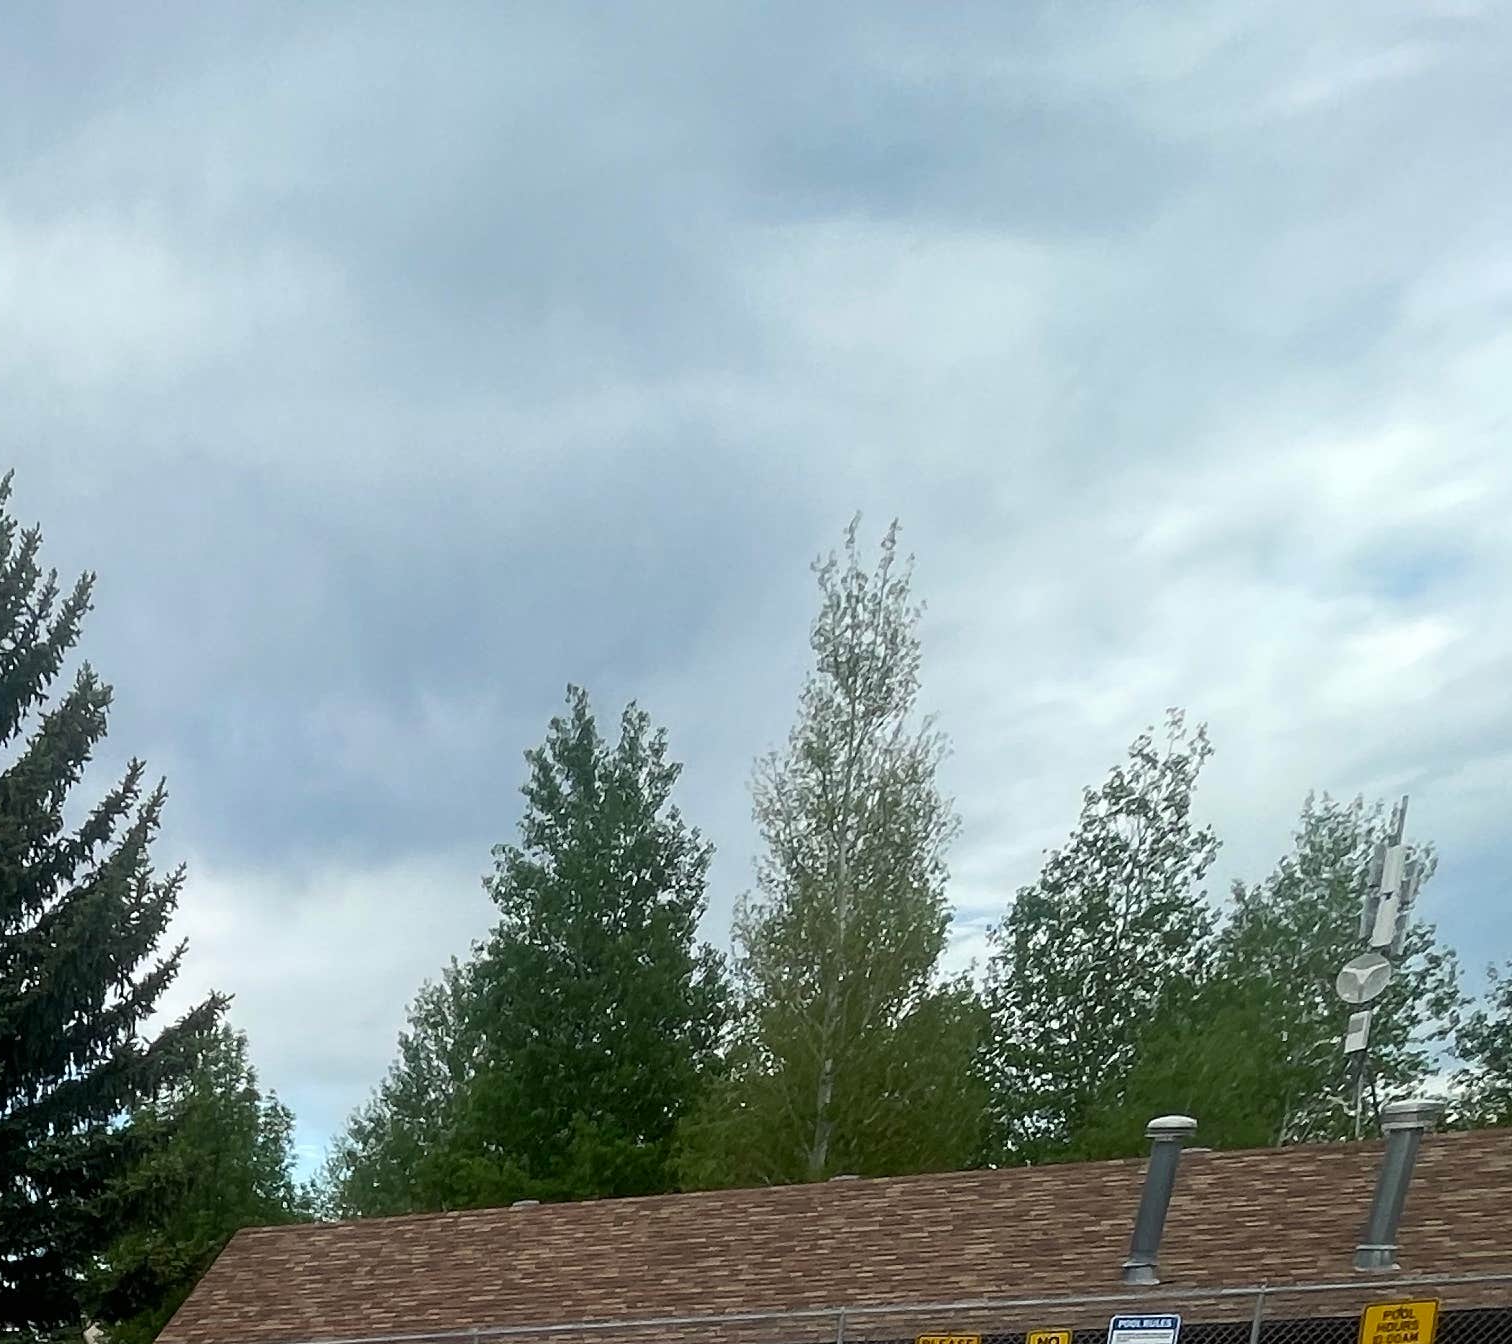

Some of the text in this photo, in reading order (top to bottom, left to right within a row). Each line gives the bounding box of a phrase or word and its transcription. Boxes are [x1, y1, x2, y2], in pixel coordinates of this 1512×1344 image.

[1383, 1308, 1415, 1320] POOL
[1118, 1319, 1172, 1328] POOL RULES
